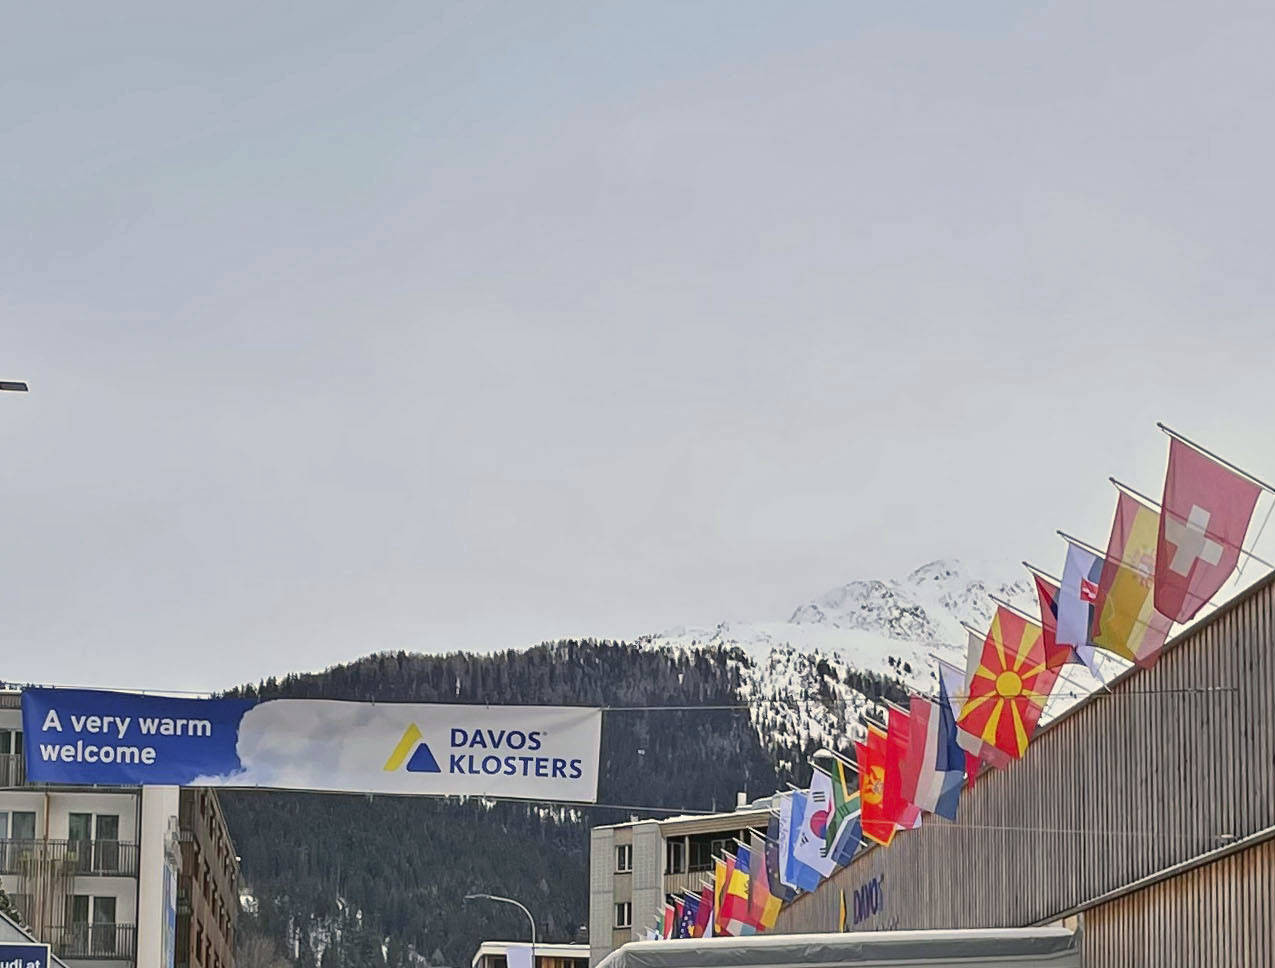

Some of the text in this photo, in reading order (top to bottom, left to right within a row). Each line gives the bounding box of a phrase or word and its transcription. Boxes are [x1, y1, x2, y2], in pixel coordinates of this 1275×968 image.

[42, 709, 212, 739] A very warm
[450, 727, 541, 751] DAVOS
[39, 740, 157, 765] welcome
[449, 754, 583, 779] KLOSTERS
